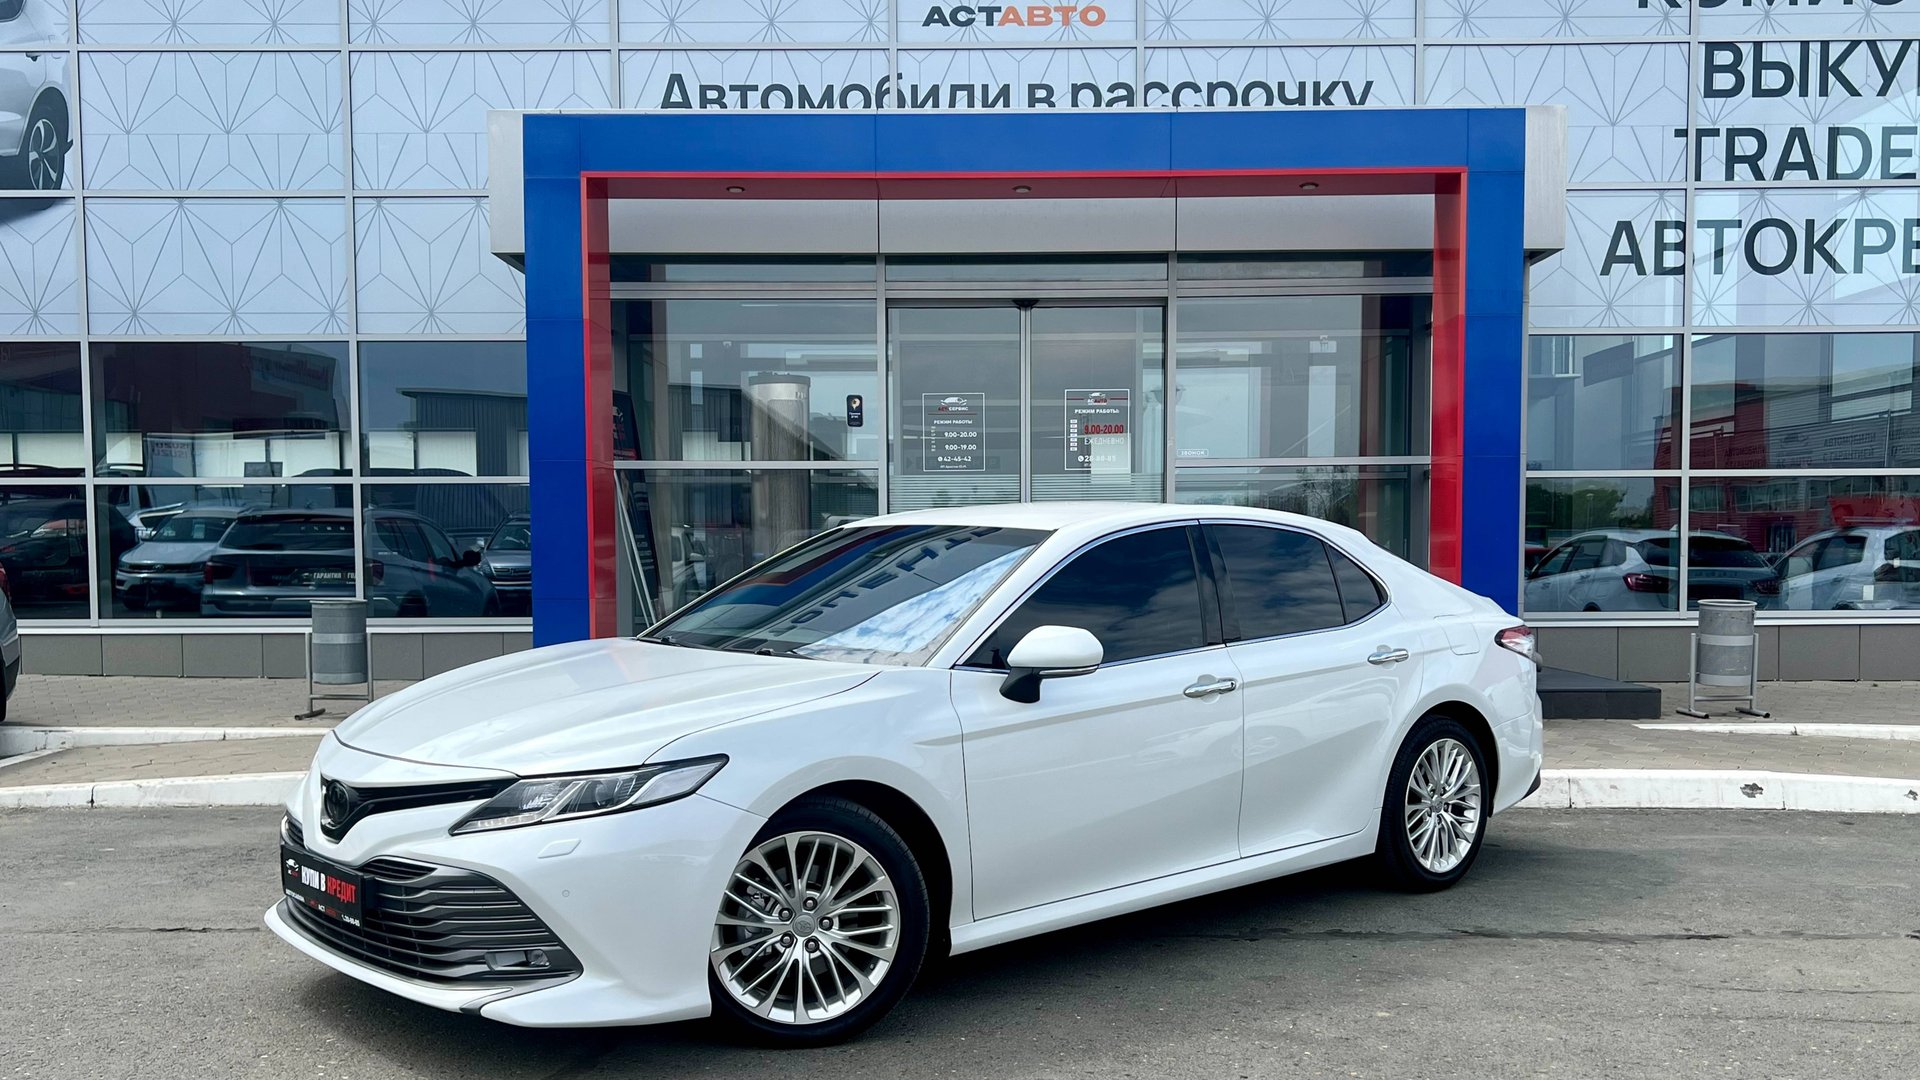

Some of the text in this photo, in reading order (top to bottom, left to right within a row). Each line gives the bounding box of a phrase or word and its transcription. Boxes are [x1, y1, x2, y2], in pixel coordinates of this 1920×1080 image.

[922, 5, 1106, 27] АСТАВТО
[1703, 42, 1920, 98] ВЫКУ
[1084, 424, 1124, 434] 9.00-20.00
[320, 872, 326, 892] В
[327, 875, 357, 903] КРЕДИТ
